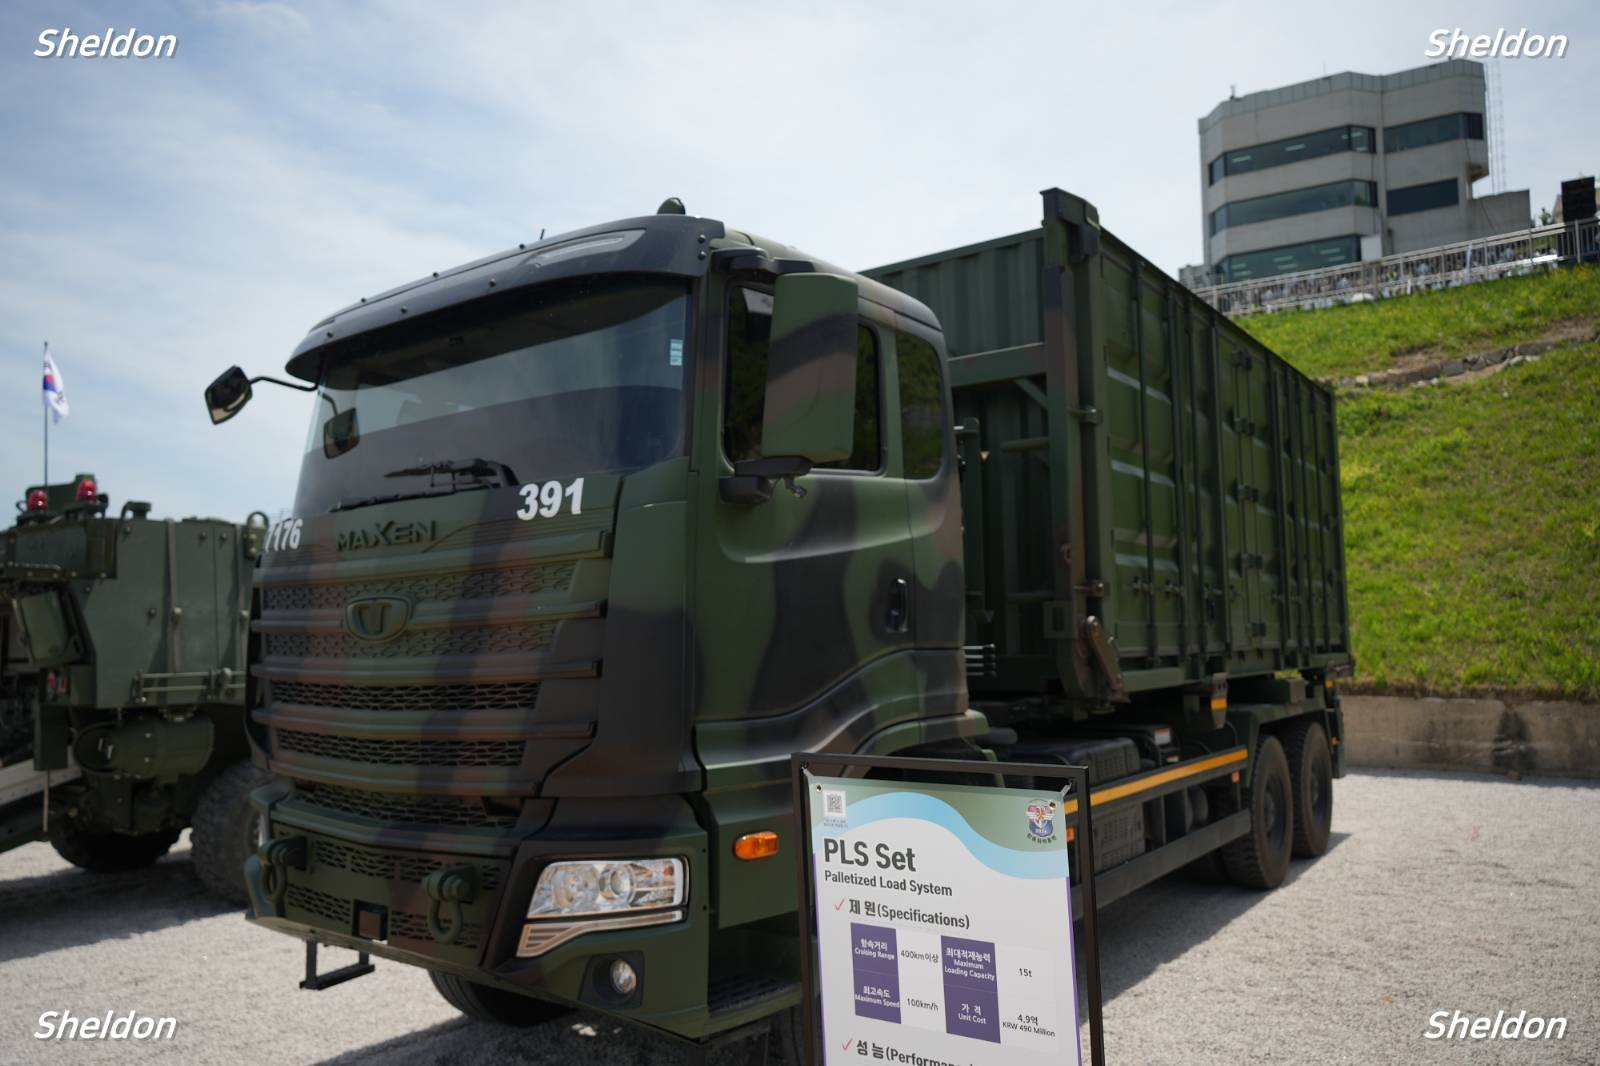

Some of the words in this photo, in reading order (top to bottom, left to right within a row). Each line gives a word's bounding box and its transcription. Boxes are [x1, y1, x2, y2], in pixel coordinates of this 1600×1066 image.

[516, 477, 585, 521] 391
[337, 520, 437, 552] MAXEN
[823, 837, 869, 867] PLS
[875, 842, 917, 872] Set
[824, 869, 877, 887] Palletized
[879, 876, 907, 891] Load
[909, 879, 953, 897] System
[849, 899, 861, 915] 제
[854, 947, 876, 958] Cruising
[877, 950, 895, 961] Range
[953, 958, 984, 970] Maximum
[944, 965, 968, 977] Loading
[969, 969, 995, 981] Capacity
[1018, 967, 1033, 978] 15t
[854, 993, 882, 1005] Maximum
[883, 998, 900, 1009] Speed
[906, 997, 939, 1012] 100km/h
[957, 1012, 971, 1022] Unit
[972, 1014, 987, 1025] Cost
[1002, 1020, 1018, 1030] KRW
[1019, 1024, 1033, 1034] 490
[1033, 1025, 1056, 1038] Million
[856, 1039, 868, 1056] 성
